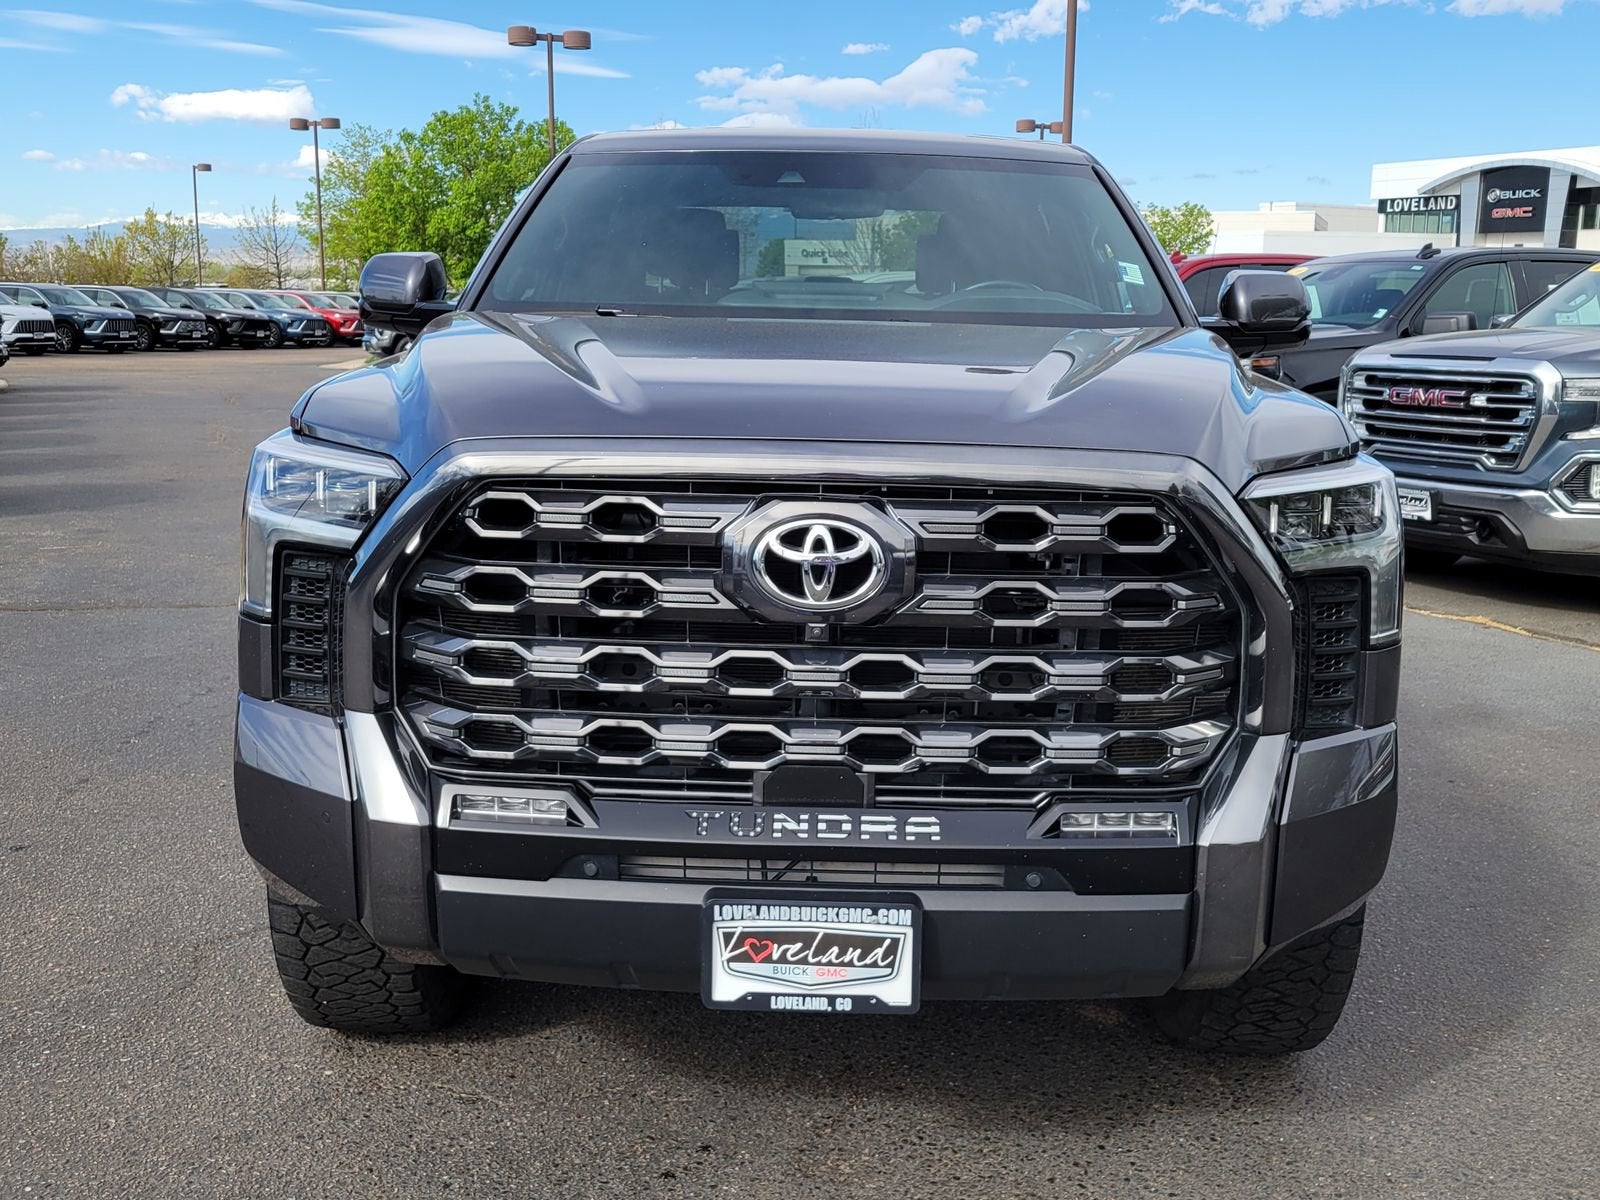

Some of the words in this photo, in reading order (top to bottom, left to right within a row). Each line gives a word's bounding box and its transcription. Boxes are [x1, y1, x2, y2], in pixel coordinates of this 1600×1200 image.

[1500, 188, 1541, 200] BUICK
[1386, 196, 1457, 213] LOVELAND
[1491, 206, 1533, 218] GMC
[801, 248, 826, 258] Quick
[1390, 386, 1466, 408] GMC
[685, 810, 941, 841] TUNDRA
[713, 904, 912, 926] LOVELANDBUICKGMC.COM
[772, 965, 809, 976] BUICK
[815, 967, 848, 978] GMC
[770, 995, 832, 1012] LOVELAND,
[835, 997, 853, 1011] CO
